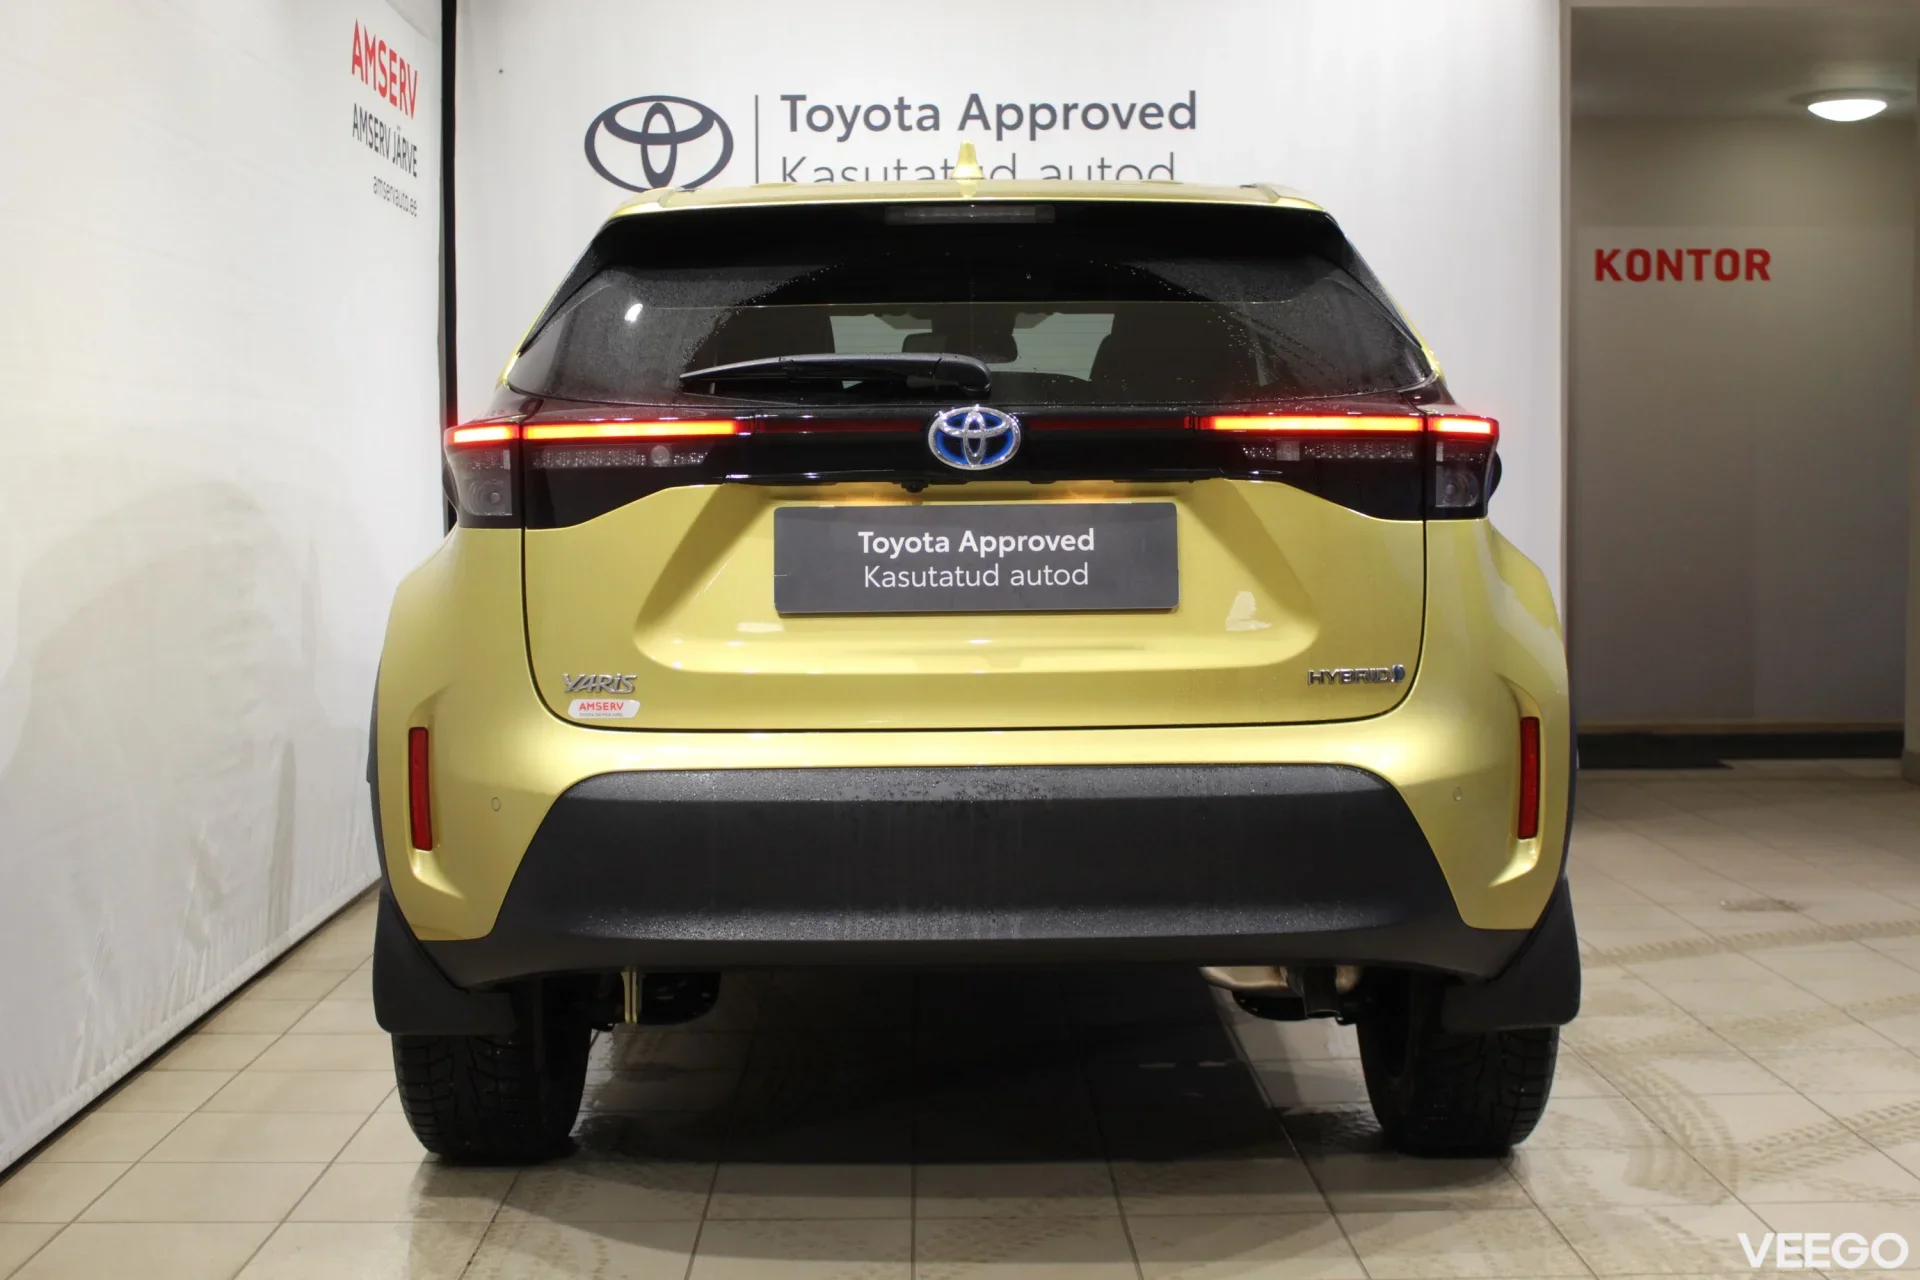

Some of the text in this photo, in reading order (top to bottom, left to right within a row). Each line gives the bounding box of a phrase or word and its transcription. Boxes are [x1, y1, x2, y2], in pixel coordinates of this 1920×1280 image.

[352, 17, 418, 120] AMSERV
[780, 90, 1196, 142] Toyota Approved
[352, 103, 418, 178] AMSERV JÄRVE
[782, 153, 1016, 182] Kasutatd
[1594, 248, 1771, 282] KONTOR
[858, 528, 1095, 559] Toyota Approved
[864, 562, 1089, 588] Kasutatud autod
[563, 673, 638, 694] YARIS
[1308, 667, 1390, 686] HYBRID
[578, 702, 625, 711] AMSERV
